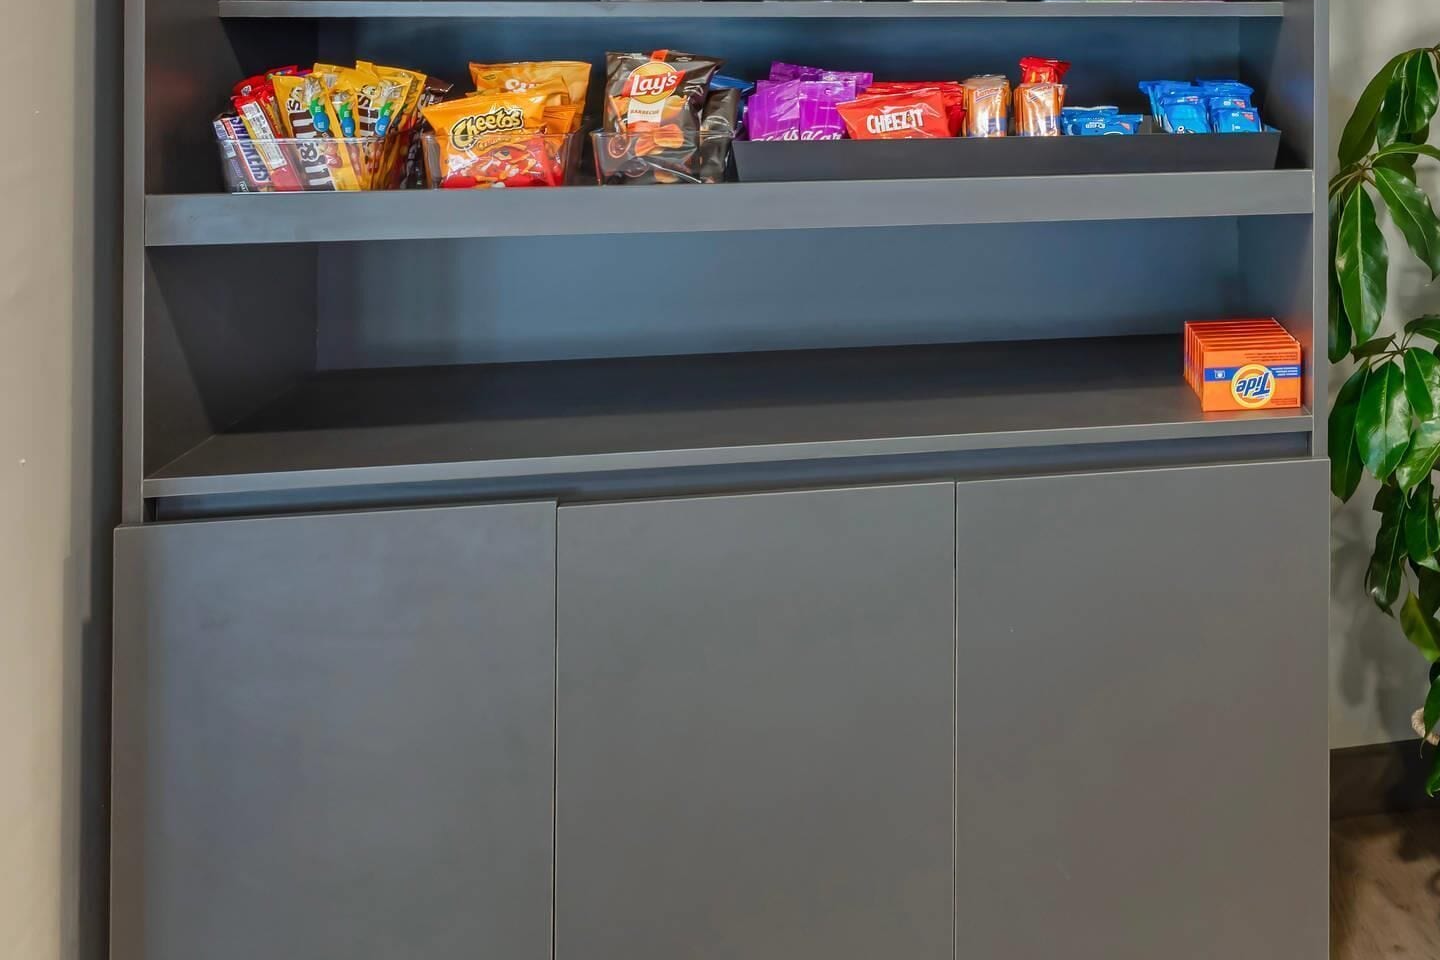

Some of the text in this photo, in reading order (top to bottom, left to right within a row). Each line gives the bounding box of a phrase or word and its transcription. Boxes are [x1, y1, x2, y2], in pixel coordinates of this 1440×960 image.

[630, 71, 678, 96] Lay's
[452, 107, 523, 149] Cheetos
[1235, 371, 1271, 397] Tide
